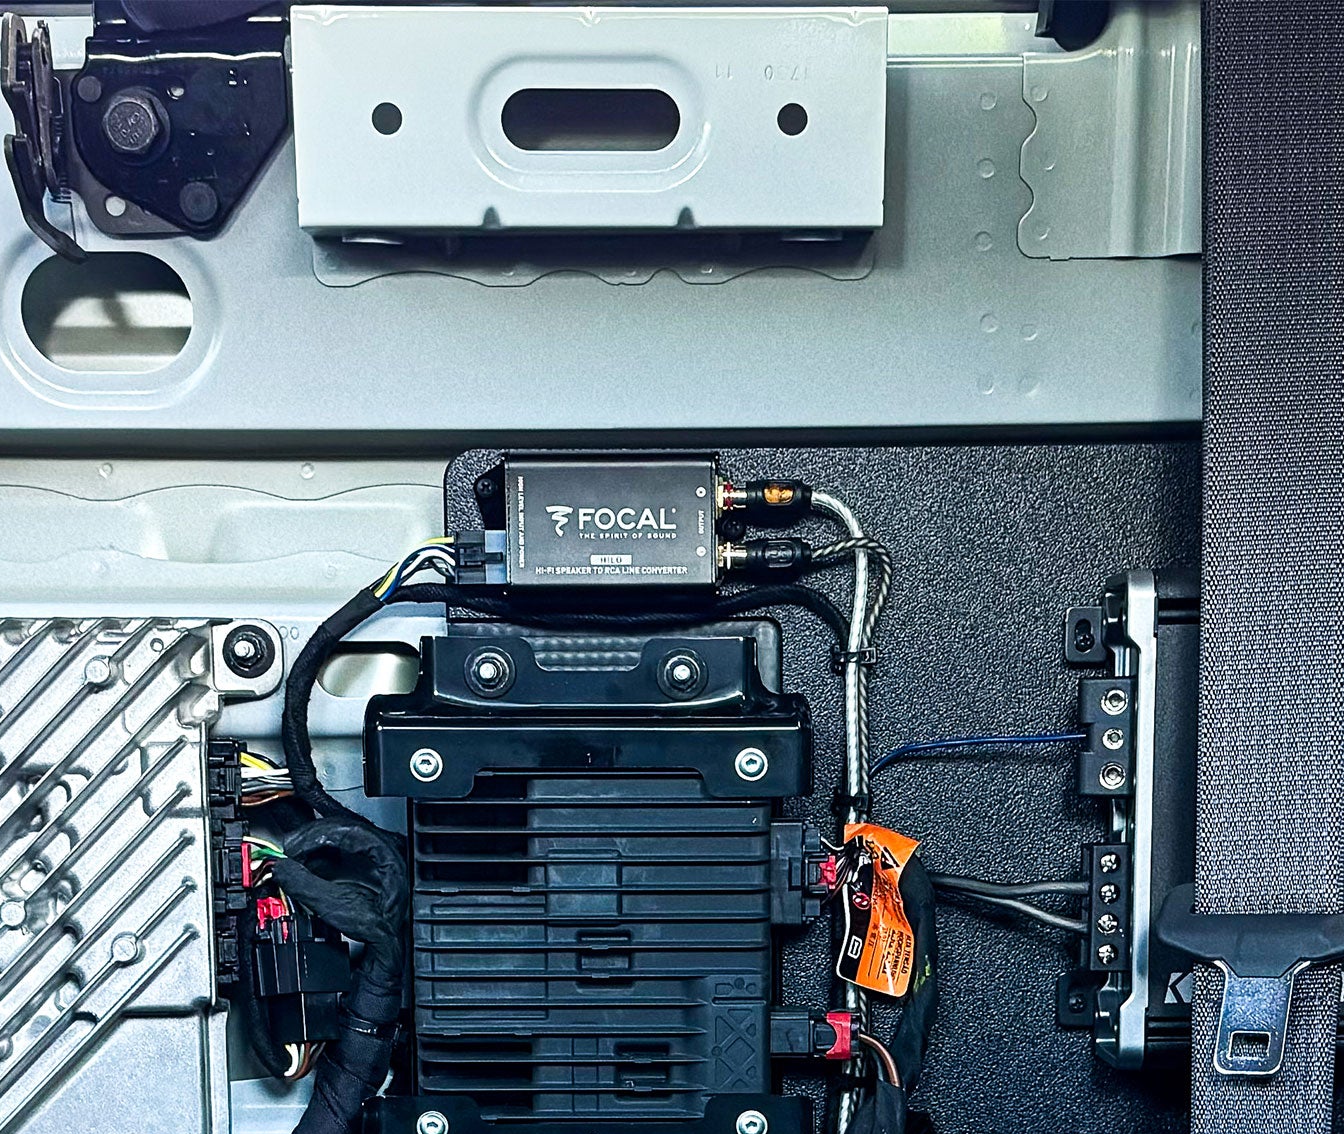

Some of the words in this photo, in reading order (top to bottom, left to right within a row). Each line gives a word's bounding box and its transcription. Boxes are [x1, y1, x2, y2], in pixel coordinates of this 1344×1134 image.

[577, 507, 678, 531] FOCAL
[535, 566, 554, 575] HI-FI
[555, 566, 592, 575] SPEAKER
[593, 566, 603, 575] TO
[605, 566, 621, 575] RCA
[622, 566, 640, 575] LINE
[641, 566, 689, 575] CONVERTER
